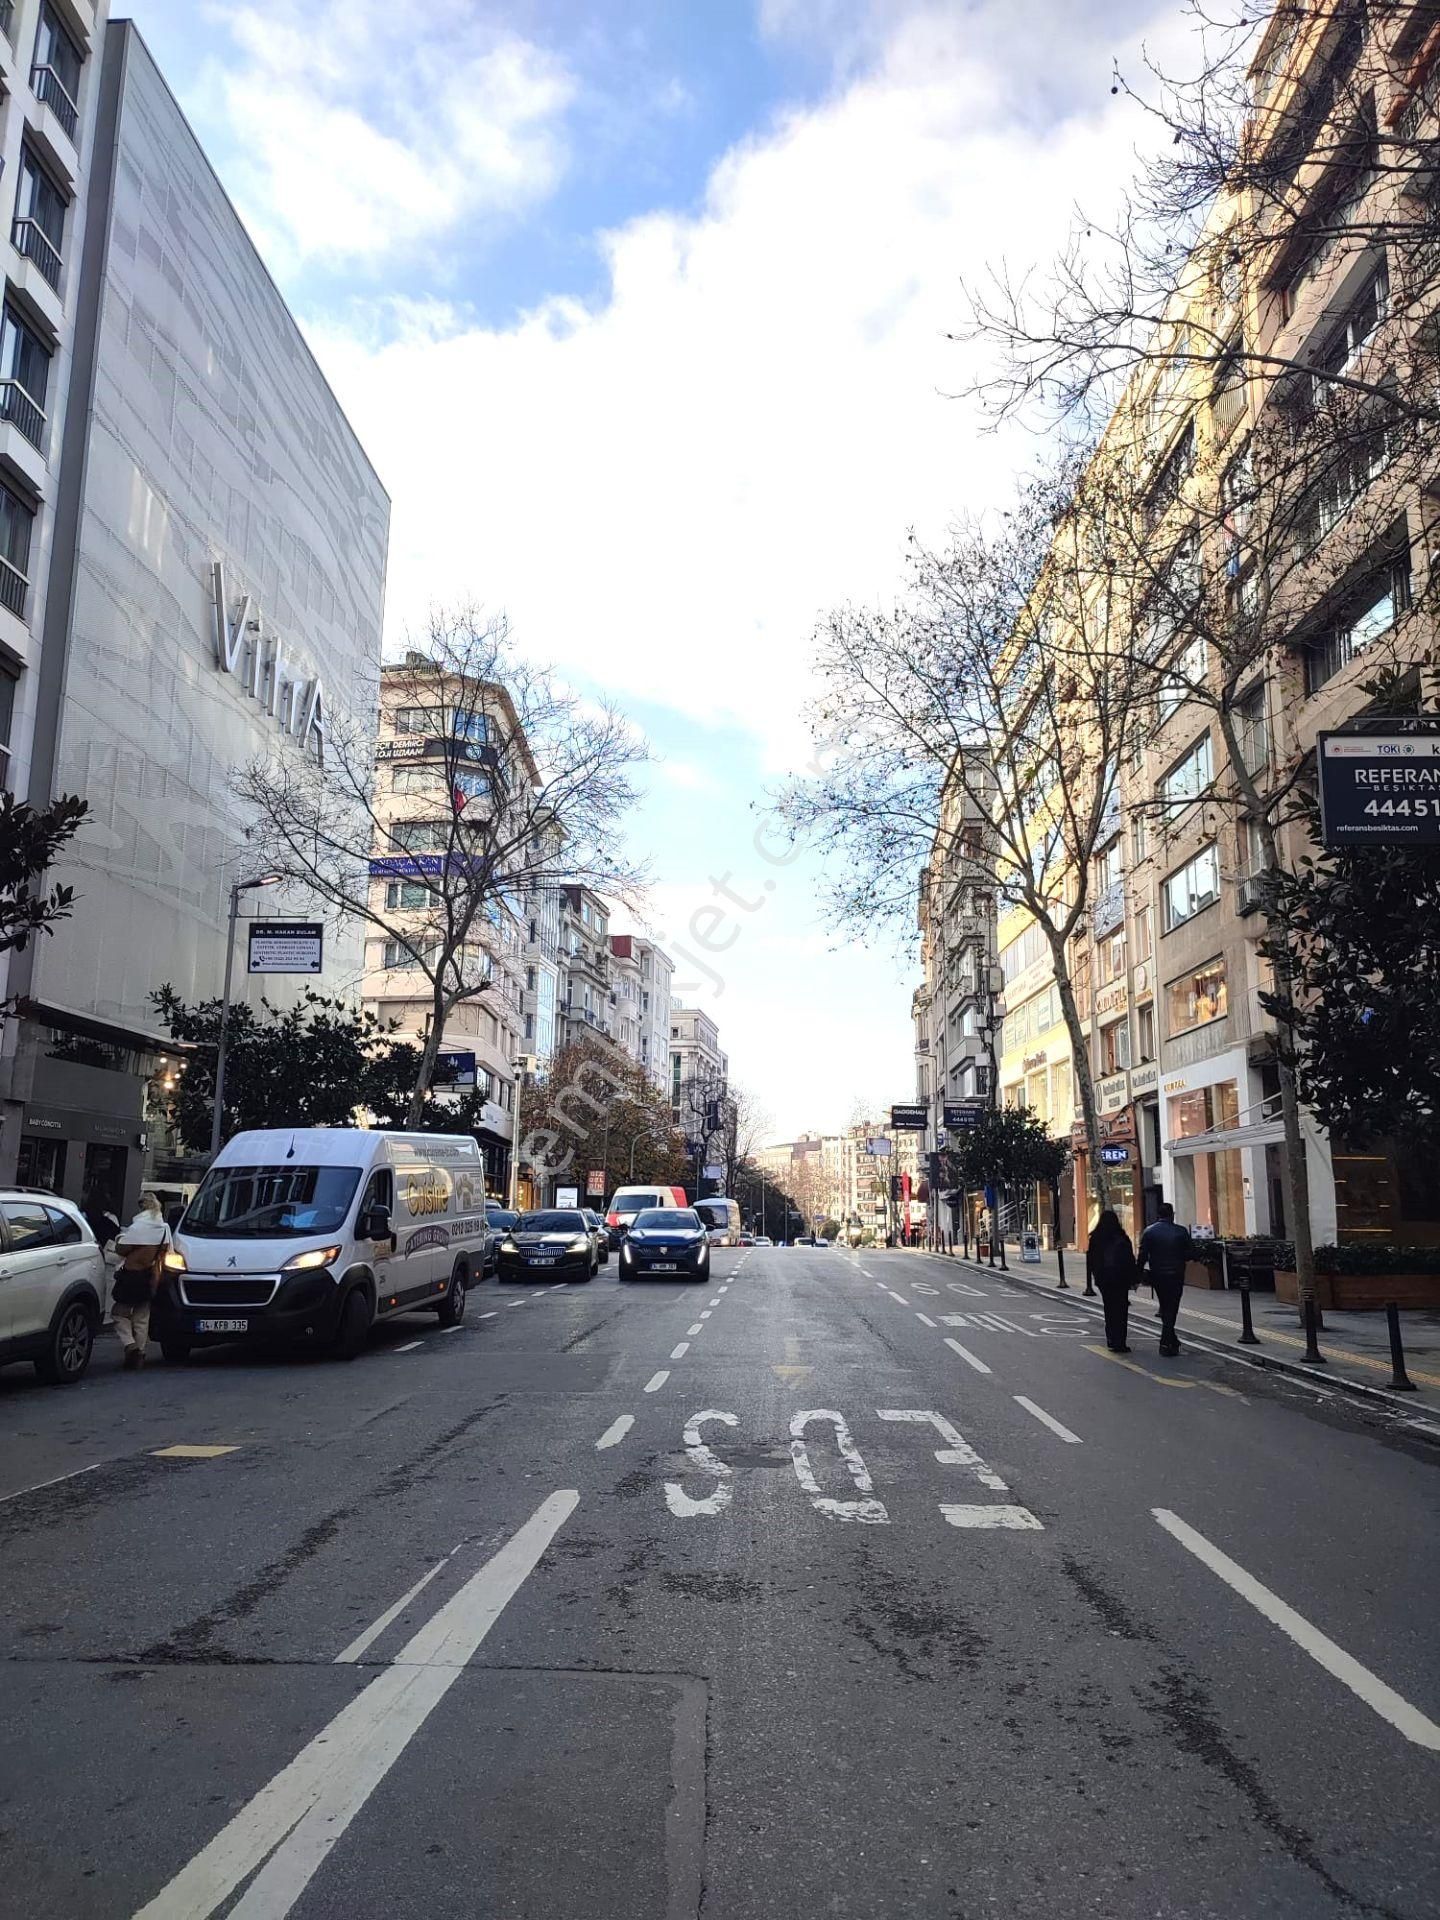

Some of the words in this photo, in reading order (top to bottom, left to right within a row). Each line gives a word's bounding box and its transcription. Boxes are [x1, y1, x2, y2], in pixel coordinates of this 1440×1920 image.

[1336, 824, 1419, 832] referansbesiktas.com
[407, 1174, 449, 1217] Cuisine
[232, 1320, 247, 1330] 335
